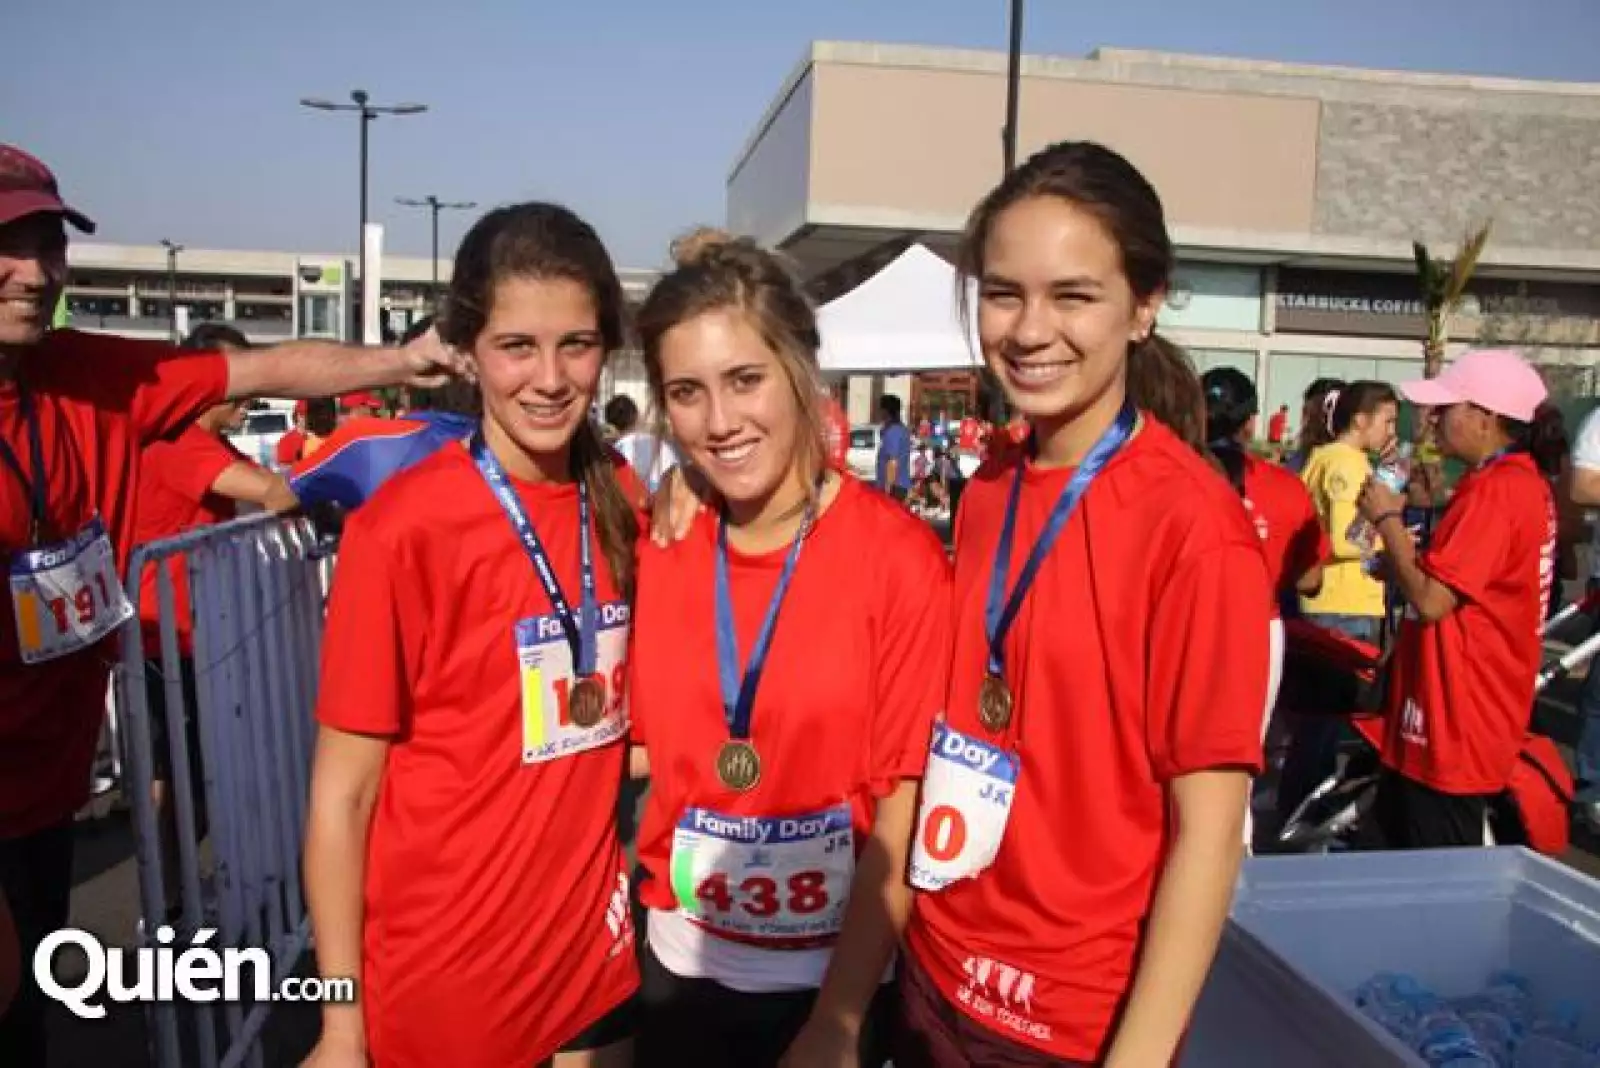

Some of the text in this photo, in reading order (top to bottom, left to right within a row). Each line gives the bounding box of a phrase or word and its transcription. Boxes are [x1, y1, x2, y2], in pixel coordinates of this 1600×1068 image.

[943, 731, 999, 772] Day
[694, 809, 774, 845] Family
[779, 814, 832, 839] Day
[923, 805, 967, 864] 0
[695, 869, 829, 919] 438
